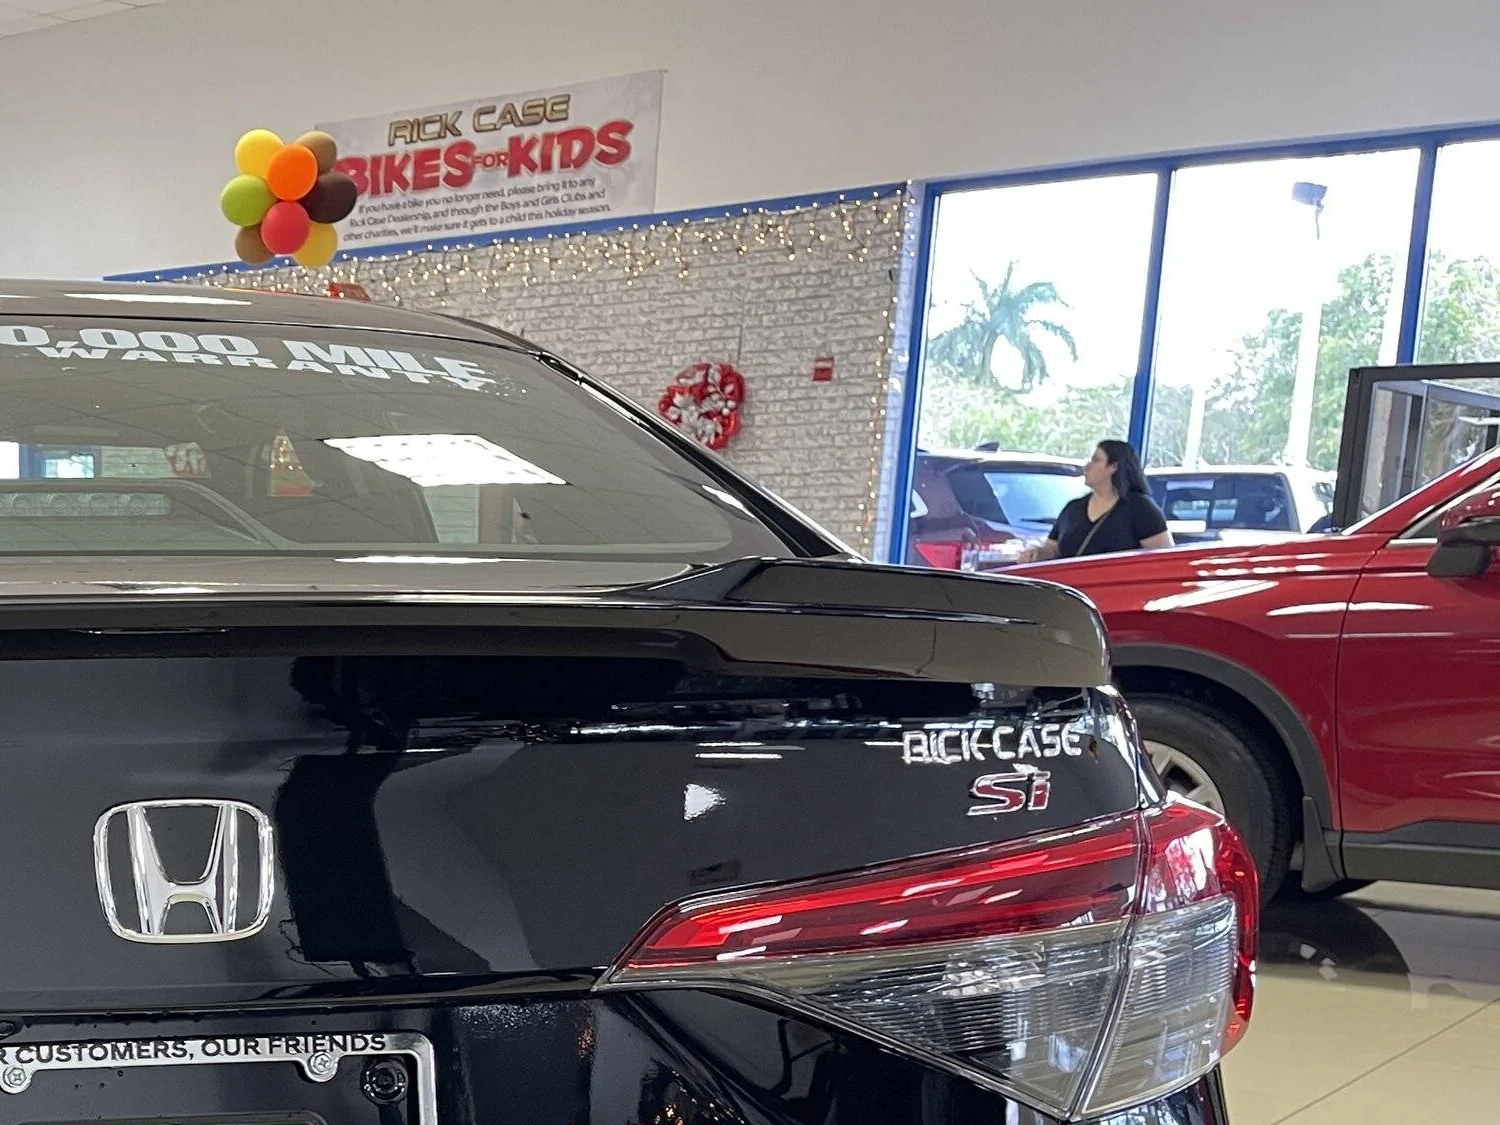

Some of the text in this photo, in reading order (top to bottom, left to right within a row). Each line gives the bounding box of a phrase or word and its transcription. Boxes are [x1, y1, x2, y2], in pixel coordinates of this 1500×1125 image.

[387, 94, 571, 146] RICK CASE
[334, 138, 477, 197] BIKES
[506, 117, 635, 179] KIDS
[507, 184, 536, 197] please
[536, 180, 560, 192] bring
[36, 346, 486, 391] WARRANTY
[282, 339, 496, 384] MILE
[991, 720, 1083, 760] CASE
[967, 770, 1051, 817] Si
[14, 1040, 194, 1064] CUSTOMERS,
[200, 1037, 260, 1058] OUR
[268, 1033, 387, 1055] FRIENDS
